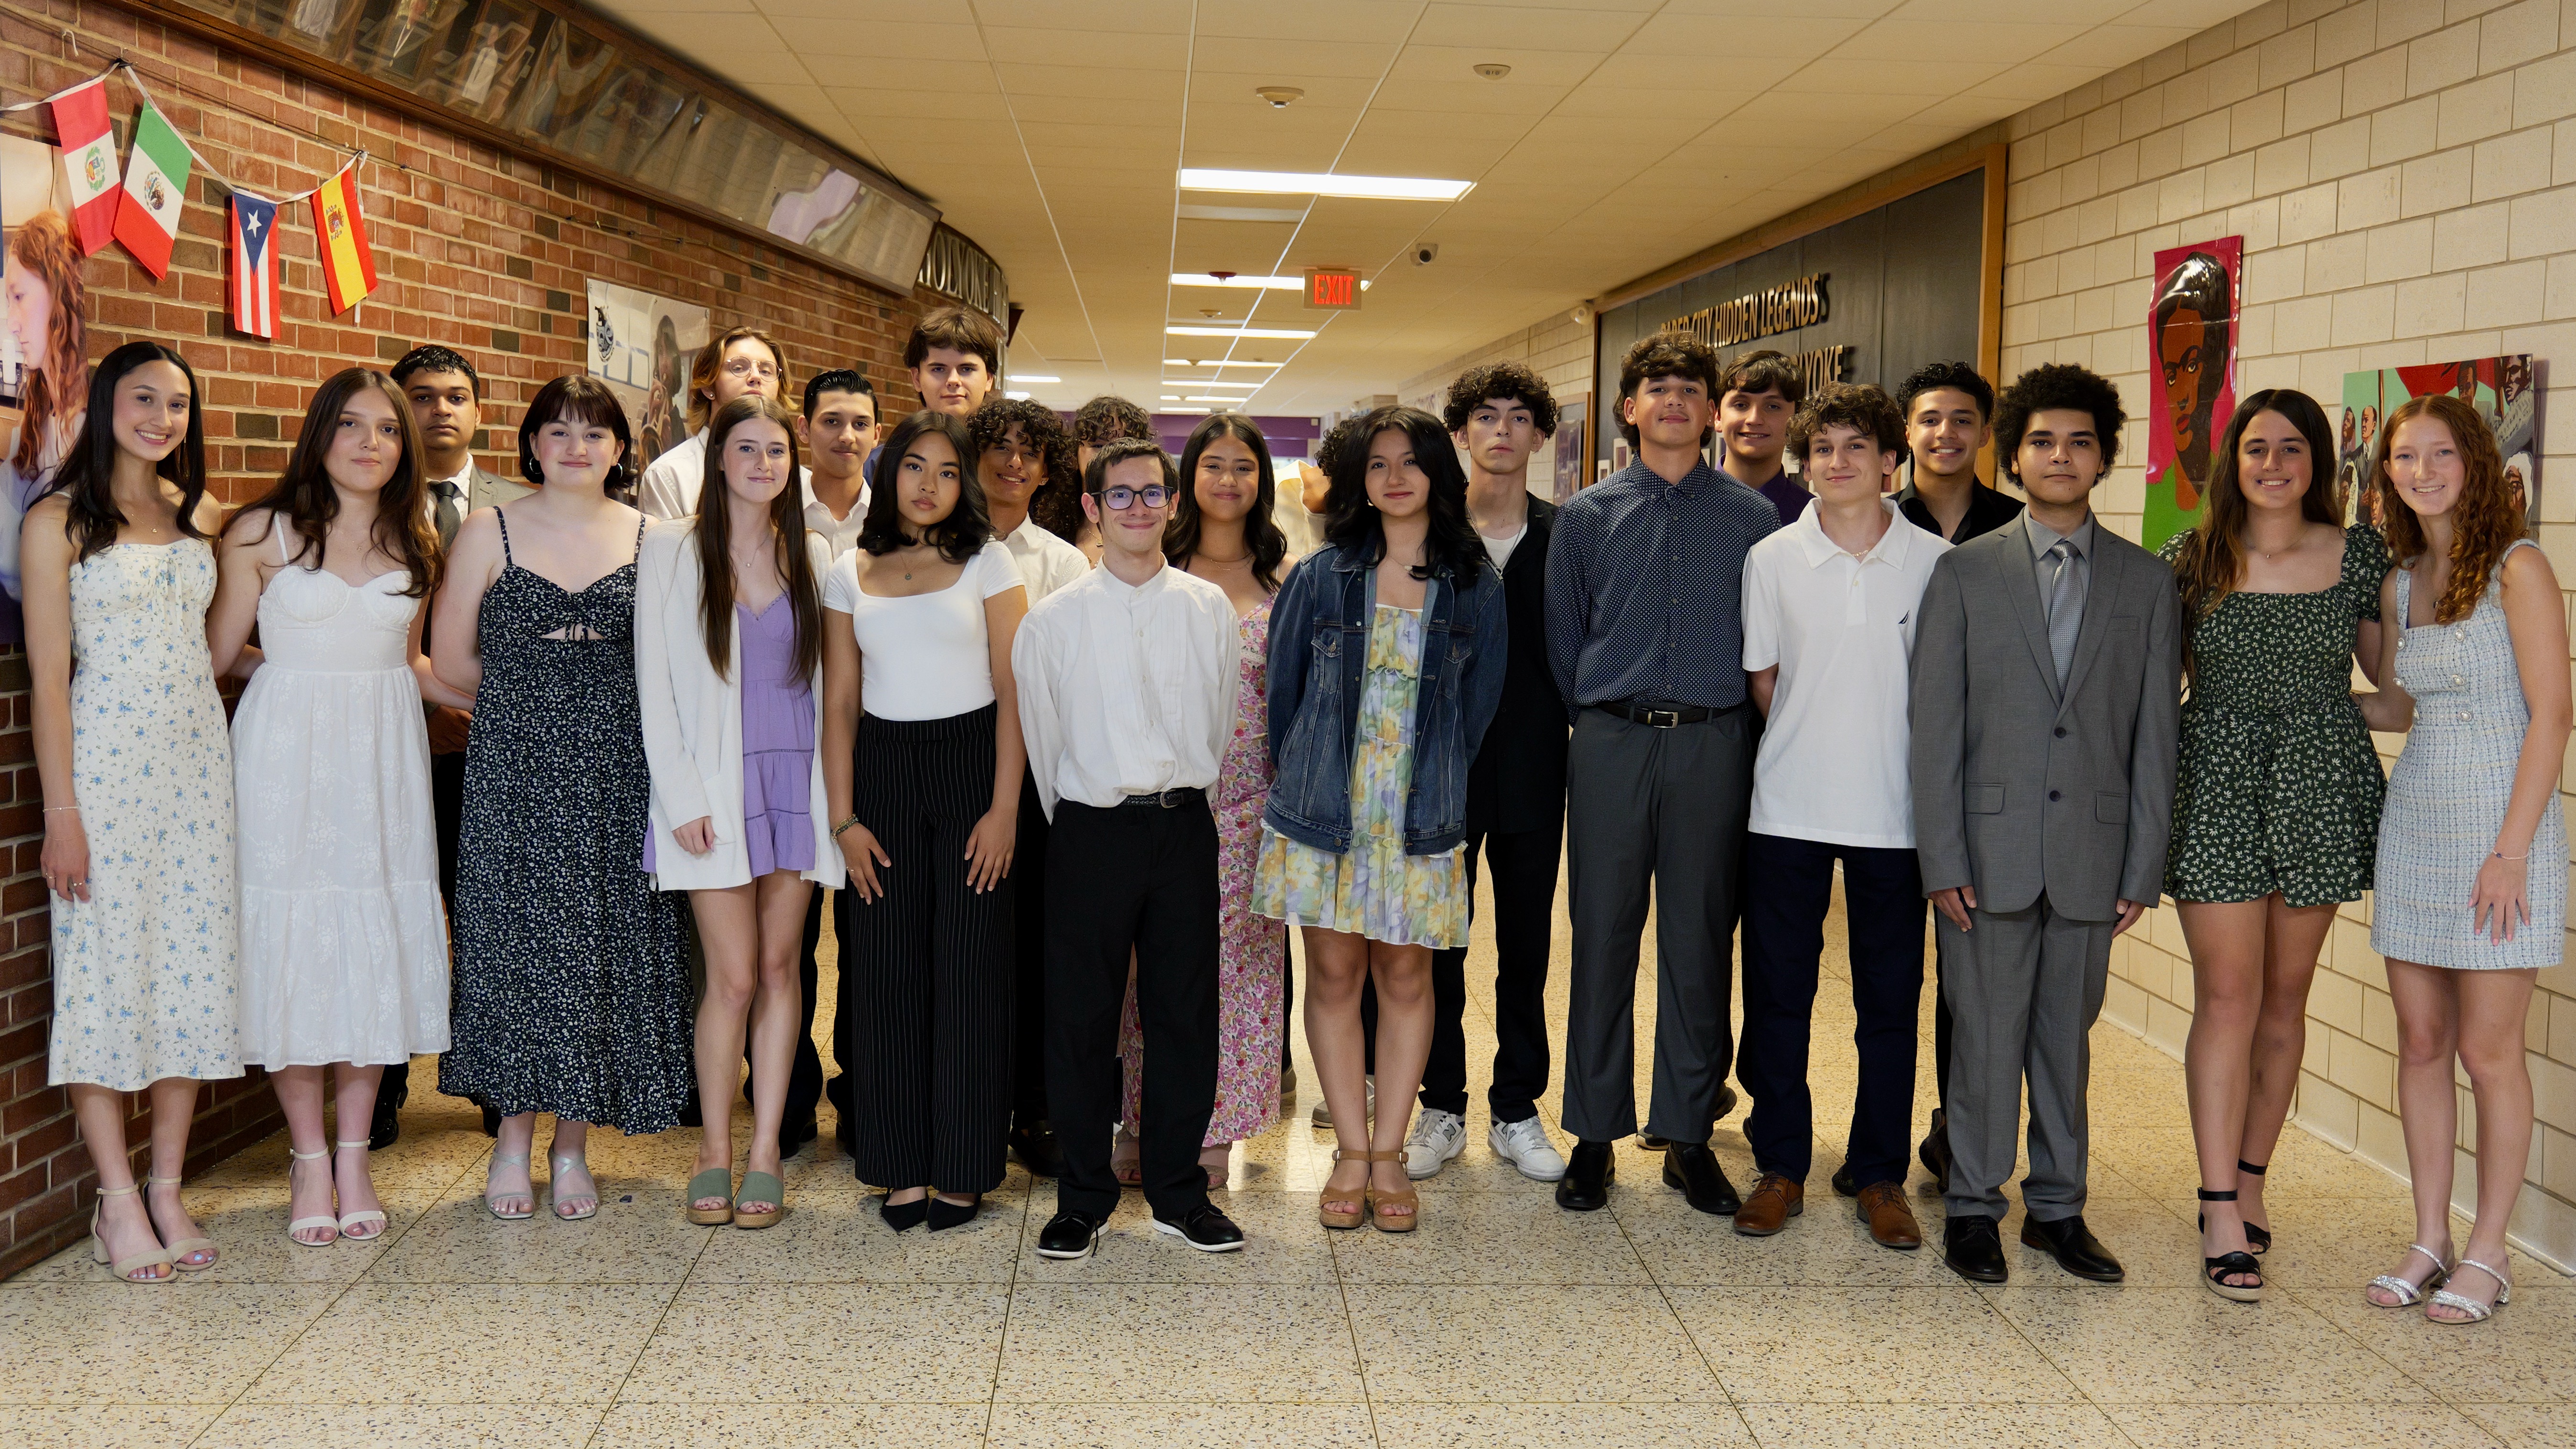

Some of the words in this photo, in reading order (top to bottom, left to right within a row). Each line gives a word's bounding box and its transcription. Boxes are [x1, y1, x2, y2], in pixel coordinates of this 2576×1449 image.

[1314, 274, 1354, 305] EXIT
[1714, 291, 1759, 348] HIDDEN
[1760, 272, 1821, 336] LEGENDS
[1790, 344, 1844, 400] YOKE
